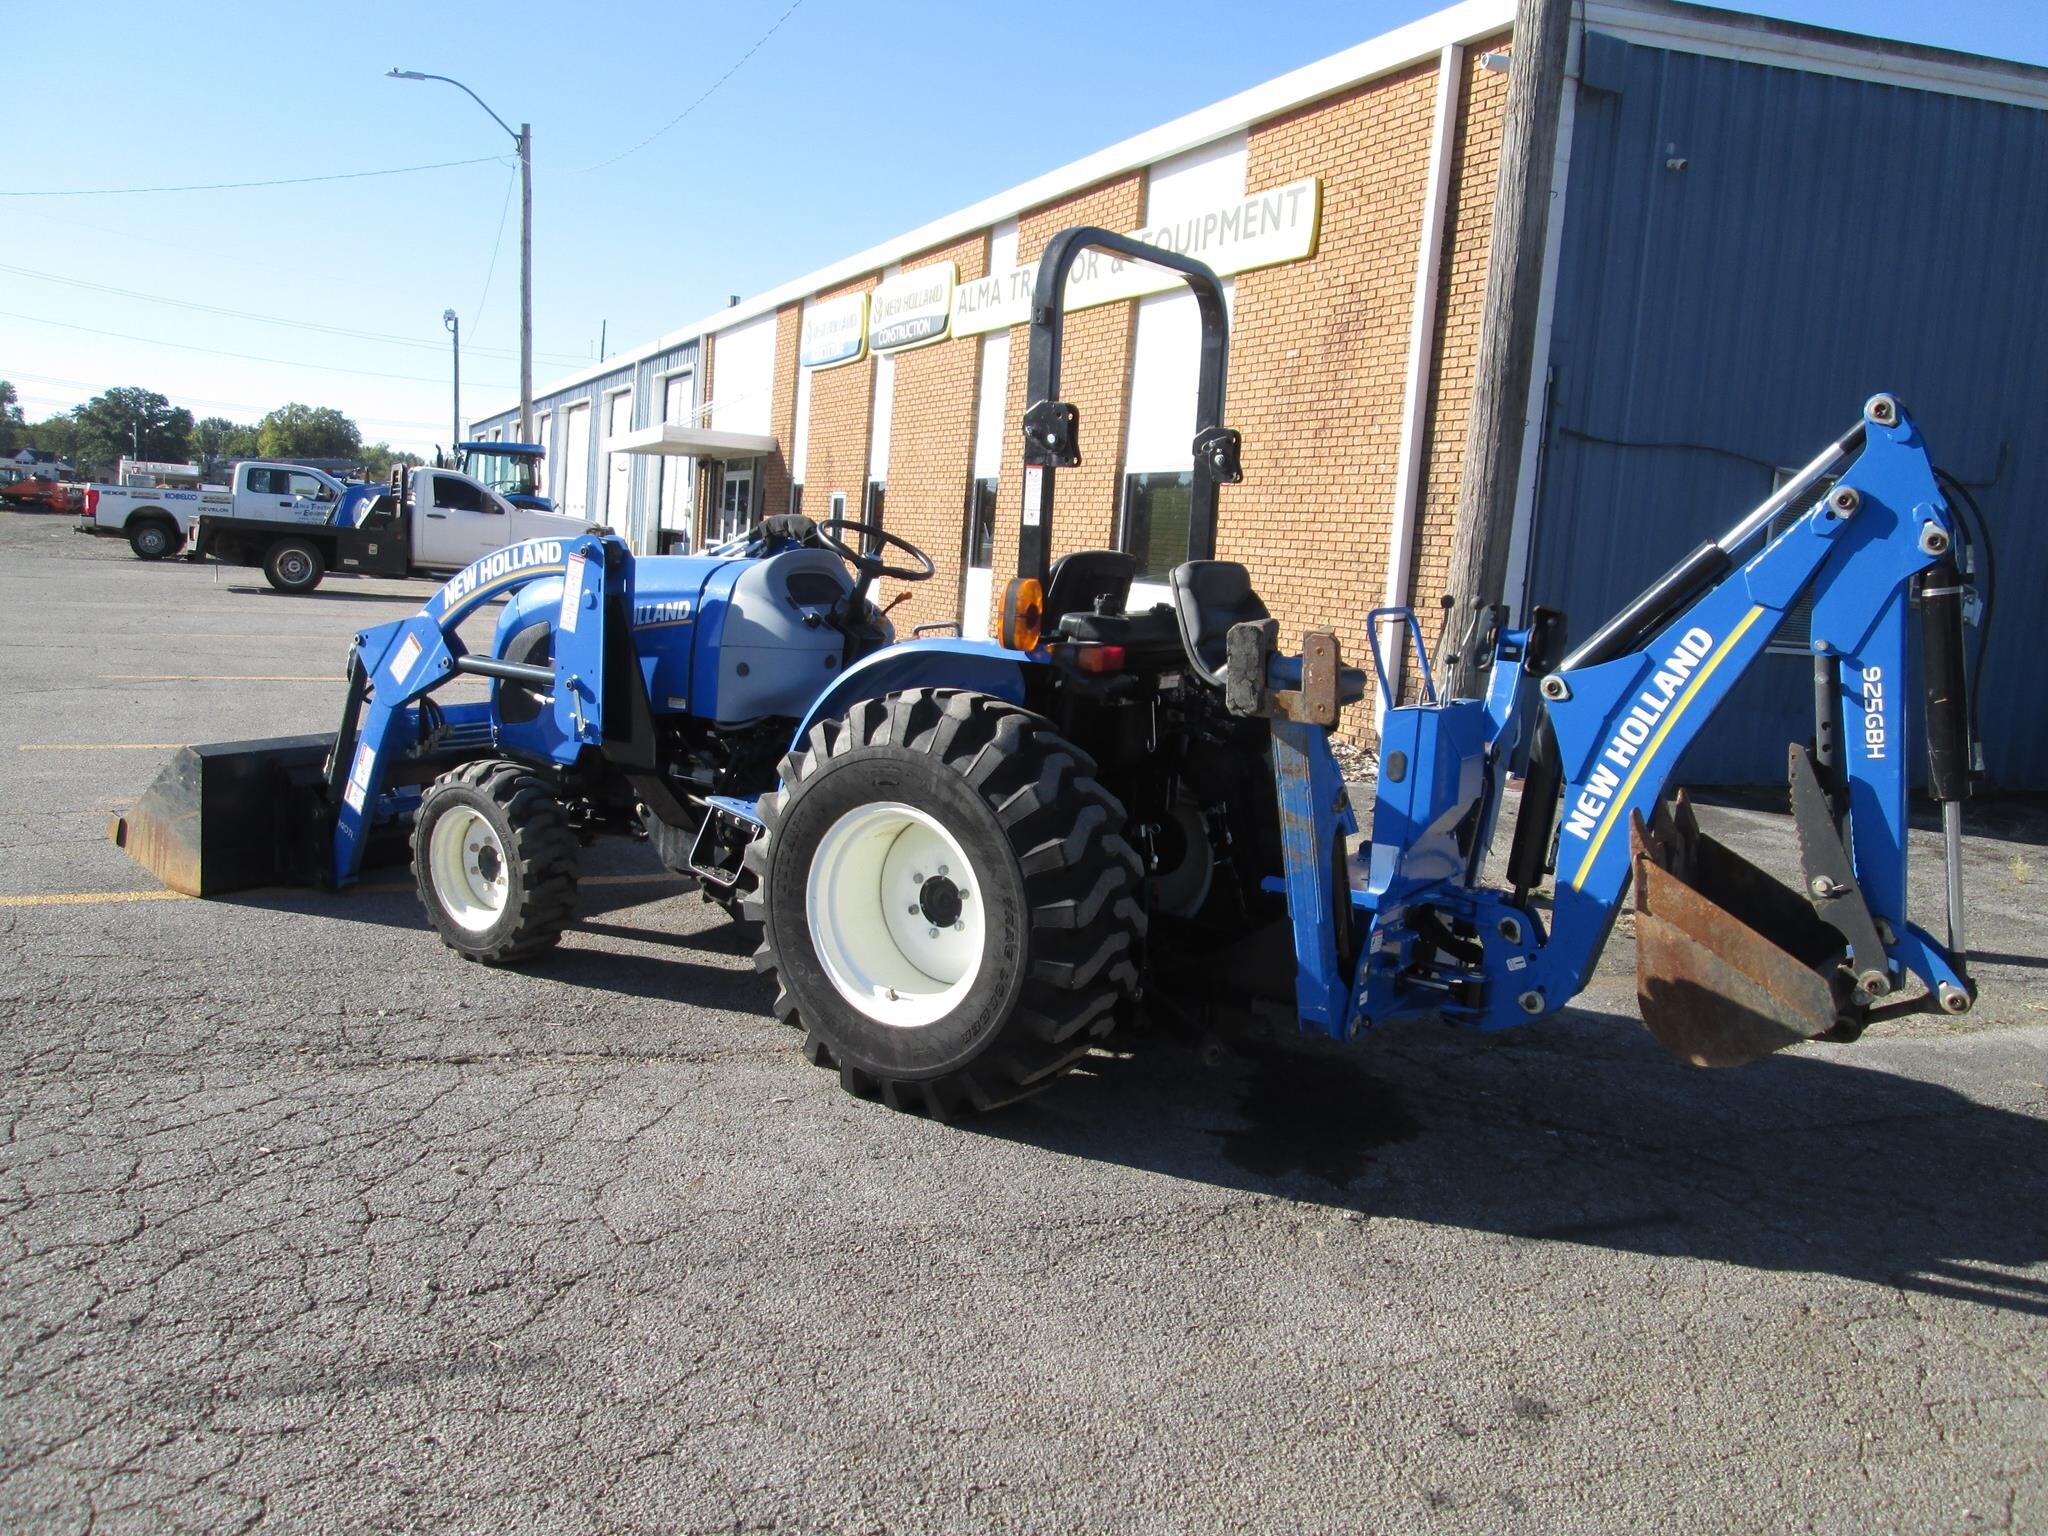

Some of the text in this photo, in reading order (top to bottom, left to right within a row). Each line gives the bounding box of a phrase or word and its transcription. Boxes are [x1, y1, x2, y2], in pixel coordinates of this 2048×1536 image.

[958, 279, 1001, 315] ALMA
[1010, 252, 1099, 301] TROR
[1141, 186, 1307, 256] QUIPMENT
[904, 284, 943, 312] HOLLAND
[878, 318, 931, 345] CONSTRUCTION
[164, 492, 198, 501] KOBELCO
[443, 541, 562, 610] NEW HOLLAND
[634, 600, 691, 626] LLAND
[1564, 626, 1714, 841] NEW HOLLAND
[1862, 666, 1886, 759] 925GBH
